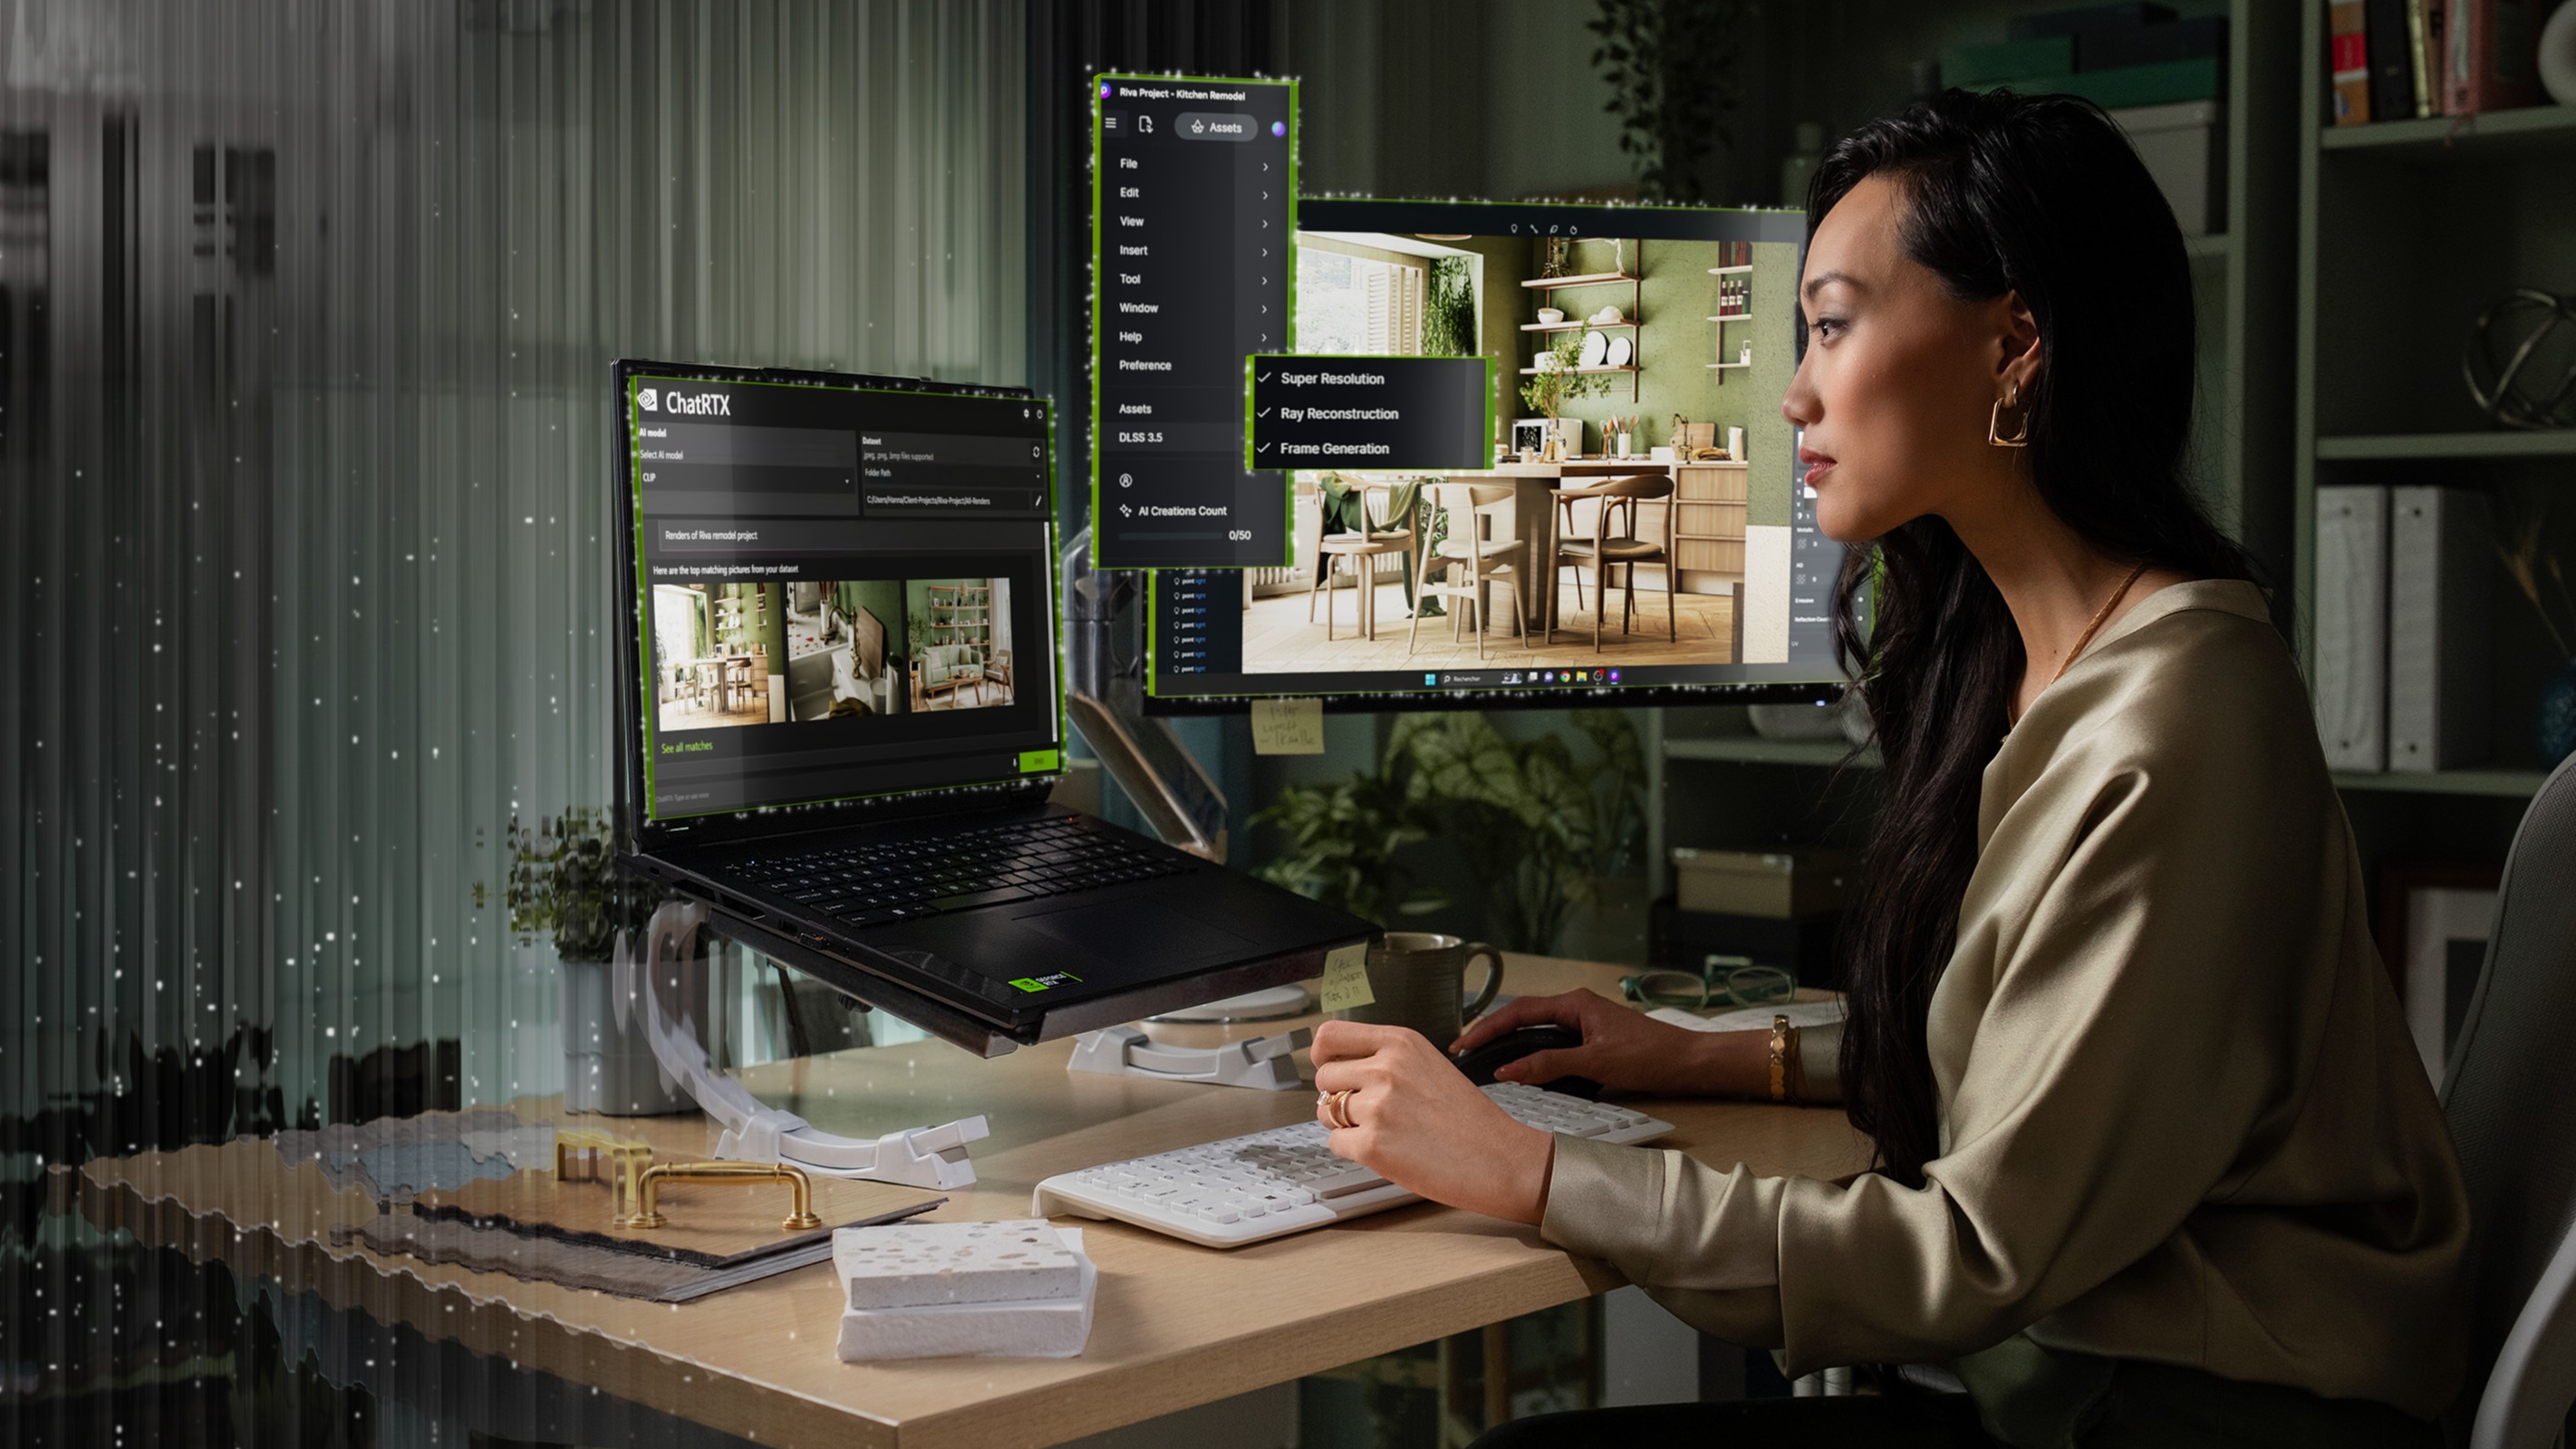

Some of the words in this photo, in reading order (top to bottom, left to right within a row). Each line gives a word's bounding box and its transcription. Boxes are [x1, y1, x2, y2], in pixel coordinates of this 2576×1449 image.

[1120, 87, 1137, 97] Riva
[1139, 88, 1169, 100] Project
[1176, 90, 1208, 100] Kitchen
[1210, 92, 1246, 101] Remodel
[1210, 122, 1242, 133] Assets
[1120, 158, 1138, 169] File
[1120, 187, 1139, 198] Edit
[1120, 216, 1144, 227] View
[1120, 245, 1148, 256] Insert
[1120, 274, 1141, 284] Tool
[1119, 303, 1159, 313] Window
[1119, 332, 1143, 343] Help
[1119, 360, 1172, 371] Preference
[1280, 372, 1317, 387] Super
[1320, 372, 1384, 384] Resolution
[666, 391, 731, 416] ChatRTX
[1119, 404, 1152, 414] Assets
[1280, 408, 1305, 422] Ray
[1307, 408, 1399, 420] Reconstruction
[639, 428, 646, 437] AI
[647, 428, 667, 438] model
[1119, 432, 1145, 442] DLSS
[1147, 432, 1163, 442] 3.5
[862, 437, 882, 446] Dataset
[1280, 442, 1319, 454] Frame
[1322, 442, 1390, 454] Generation
[640, 449, 658, 459] Select
[665, 450, 683, 460] model
[911, 453, 933, 462] supported
[642, 472, 656, 482] CLIP
[864, 468, 880, 477] Folder
[881, 469, 892, 477] Path
[1138, 507, 1149, 516] AI
[1151, 506, 1197, 516] Creations
[1198, 507, 1228, 516] Count
[665, 530, 690, 540] Renders
[691, 530, 699, 539] of
[699, 530, 711, 539] Riva
[712, 530, 737, 540] remodel
[737, 530, 757, 542] project
[1229, 530, 1251, 541] 0/50
[653, 565, 667, 575] Here
[668, 567, 678, 575] are
[679, 565, 689, 575] the
[690, 566, 699, 577] top
[700, 565, 728, 576] matching
[728, 565, 750, 576] pictures
[751, 565, 764, 575] from
[765, 566, 777, 575] your
[779, 565, 799, 574] dataset
[661, 742, 674, 754] See
[675, 741, 684, 752] all
[684, 739, 713, 752] matches
